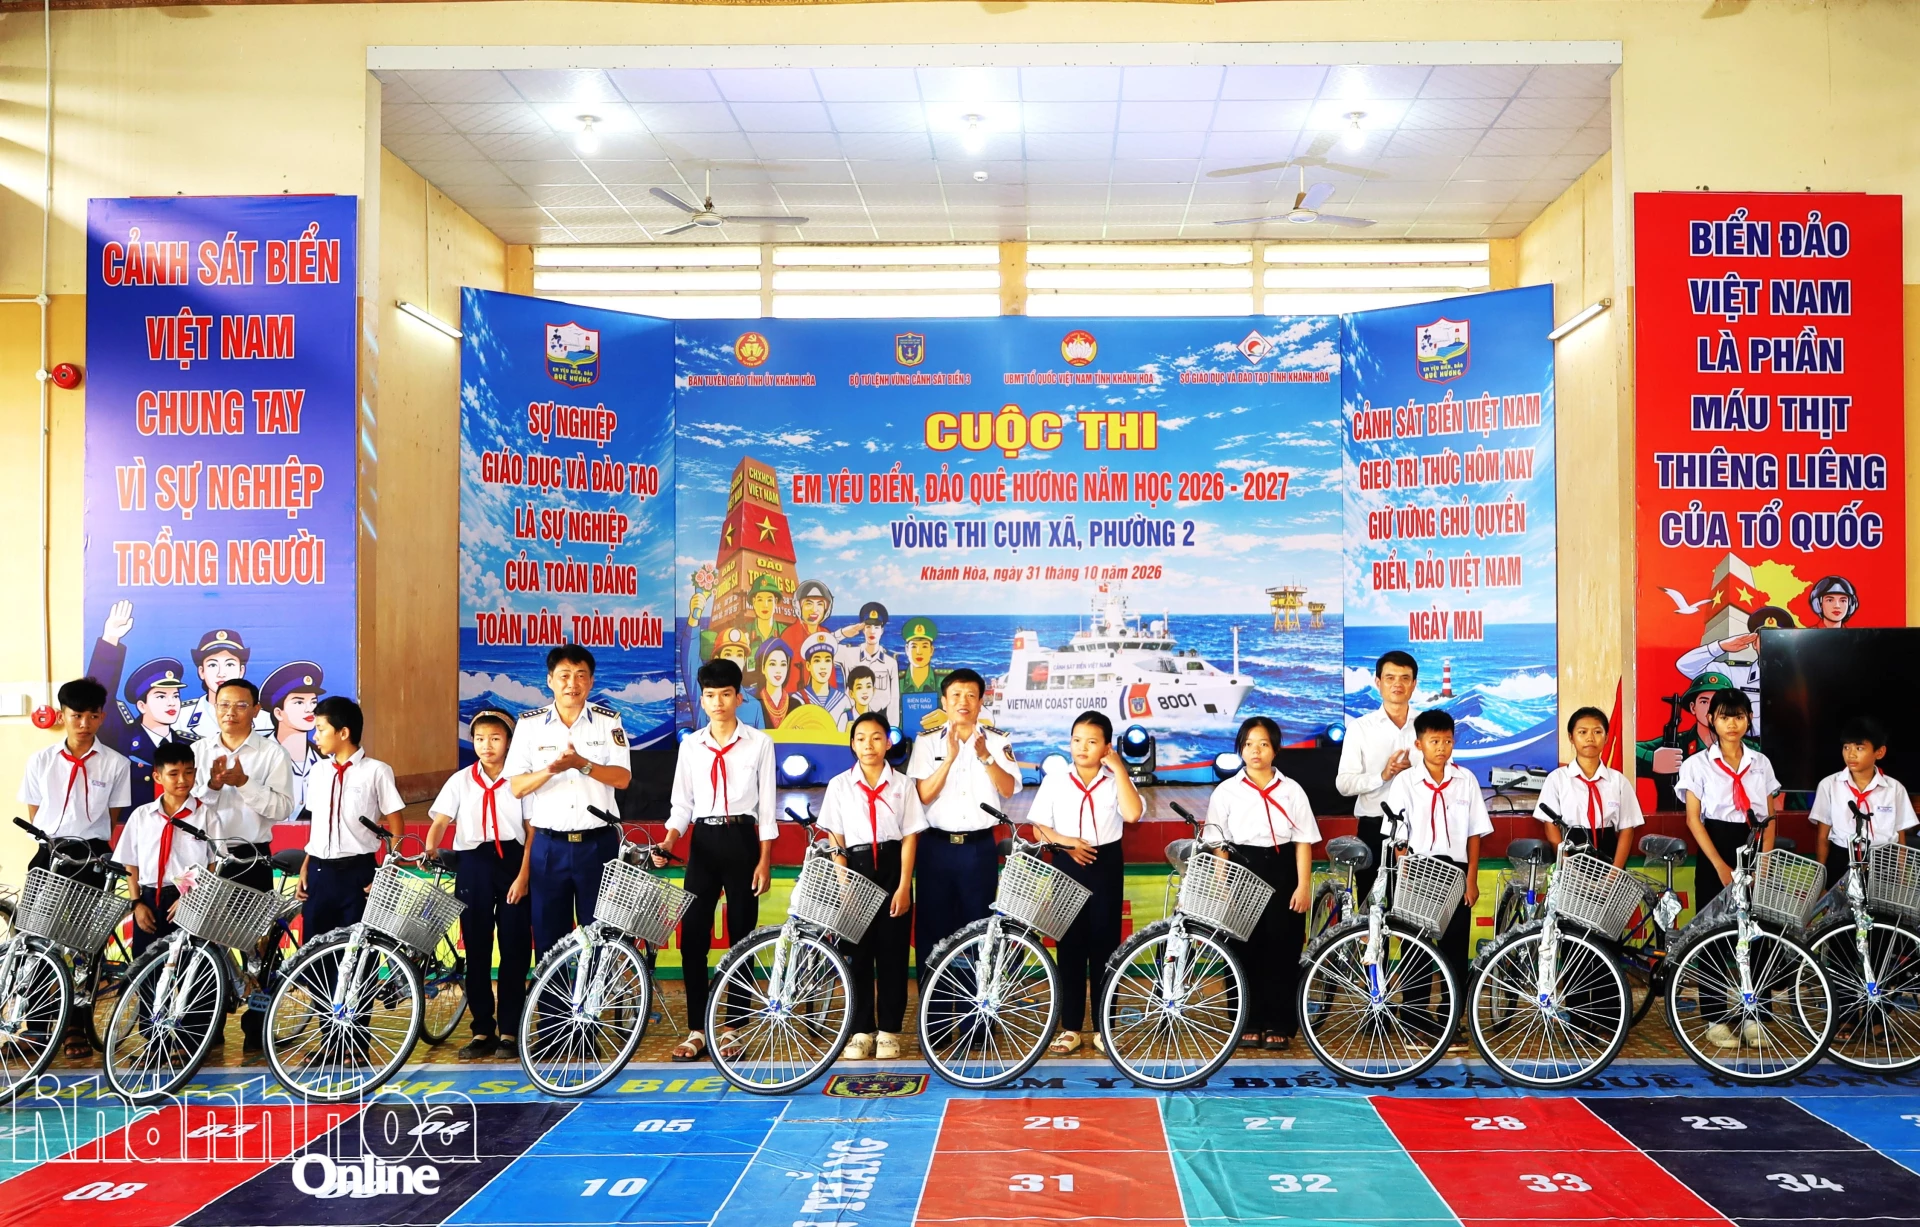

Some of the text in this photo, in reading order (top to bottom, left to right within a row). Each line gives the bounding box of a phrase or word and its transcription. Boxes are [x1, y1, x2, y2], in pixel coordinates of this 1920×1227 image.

[103, 222, 339, 286] CẢNH SÁT BIỂN
[1690, 208, 1850, 258] BIỂN ĐẢO
[1688, 272, 1850, 322] VIỆT NAM
[146, 307, 294, 369] VIỆT NAM
[1697, 326, 1843, 374] LÀ PHẦN
[688, 372, 816, 386] BAN TUYÊN GIÁO TỈNH ỦY KHÁNH HÒA
[849, 370, 971, 388] BỘ TƯ LỆNH VÙNG CẢNH SÁT BIỂN 3
[1004, 369, 1154, 386] UBMT TỔ QUỐC VIỆT NAM TỈNH KHÁNH HÒA
[1180, 369, 1330, 386] SỞ GIÁO DỤC VÀ ĐÀO TẠO TỈNH KHÁNH HÒA
[136, 389, 305, 435] CHUNG TAY
[528, 400, 617, 448] SỰ NGHIỆP
[924, 404, 1157, 458] CUỘC THI
[1353, 389, 1541, 442] CẢNH SÁT BIỂN VIỆT NAM
[1691, 388, 1852, 439] MÁU THỊT
[116, 456, 324, 520] VÌ SỰ NGHIỆP
[481, 447, 660, 501] GIÁO DỤC VÀ ĐÀO TẠO
[748, 467, 774, 488] CHXHCN
[792, 462, 1290, 508] EM YÊU BIỂN, ĐẢO QUÊ HƯƠNG NĂM HỌC 2026 2027
[1359, 445, 1535, 491] GIEO TRI THỨC HÔM NAY
[1654, 446, 1887, 490] THIÊNG LIÊNG
[748, 482, 779, 505] VIỆT NAM
[514, 502, 628, 550] LÀ SỰ NGHIỆP
[891, 514, 1195, 554] VÒNG THI CỤM XÃ, PHƯỜNG 2
[1368, 494, 1526, 542] GIỮ VỮNG CHỦ QUYỀN
[1659, 498, 1882, 552] CỦA TỔ QUỐC
[114, 526, 325, 586] TRỒNG NGƯỜI
[505, 550, 638, 596] CỦA TOÀN ĐẢNG
[920, 565, 1162, 582] Khánh Hòa, ngày 31 tháng 10 năm 2026
[1372, 549, 1522, 595] BIỂN, ĐẢO VIỆT NAM
[476, 608, 662, 650] TOÀN DÂN, TOÀN QUÂN
[1408, 606, 1484, 642] NGÀY MAI
[1007, 692, 1197, 710] VIETNAM COAST GUARD 8001
[632, 1119, 696, 1132] 05
[1022, 1115, 1080, 1130] 26
[1243, 1116, 1297, 1130] 27
[1464, 1115, 1527, 1131] 28
[1681, 1115, 1748, 1131] 29
[62, 1182, 148, 1201] 08
[580, 1178, 648, 1197] 10
[1008, 1174, 1073, 1193] 31
[1268, 1174, 1338, 1193] 32
[1519, 1173, 1592, 1193] 33
[1766, 1173, 1846, 1193] 34
